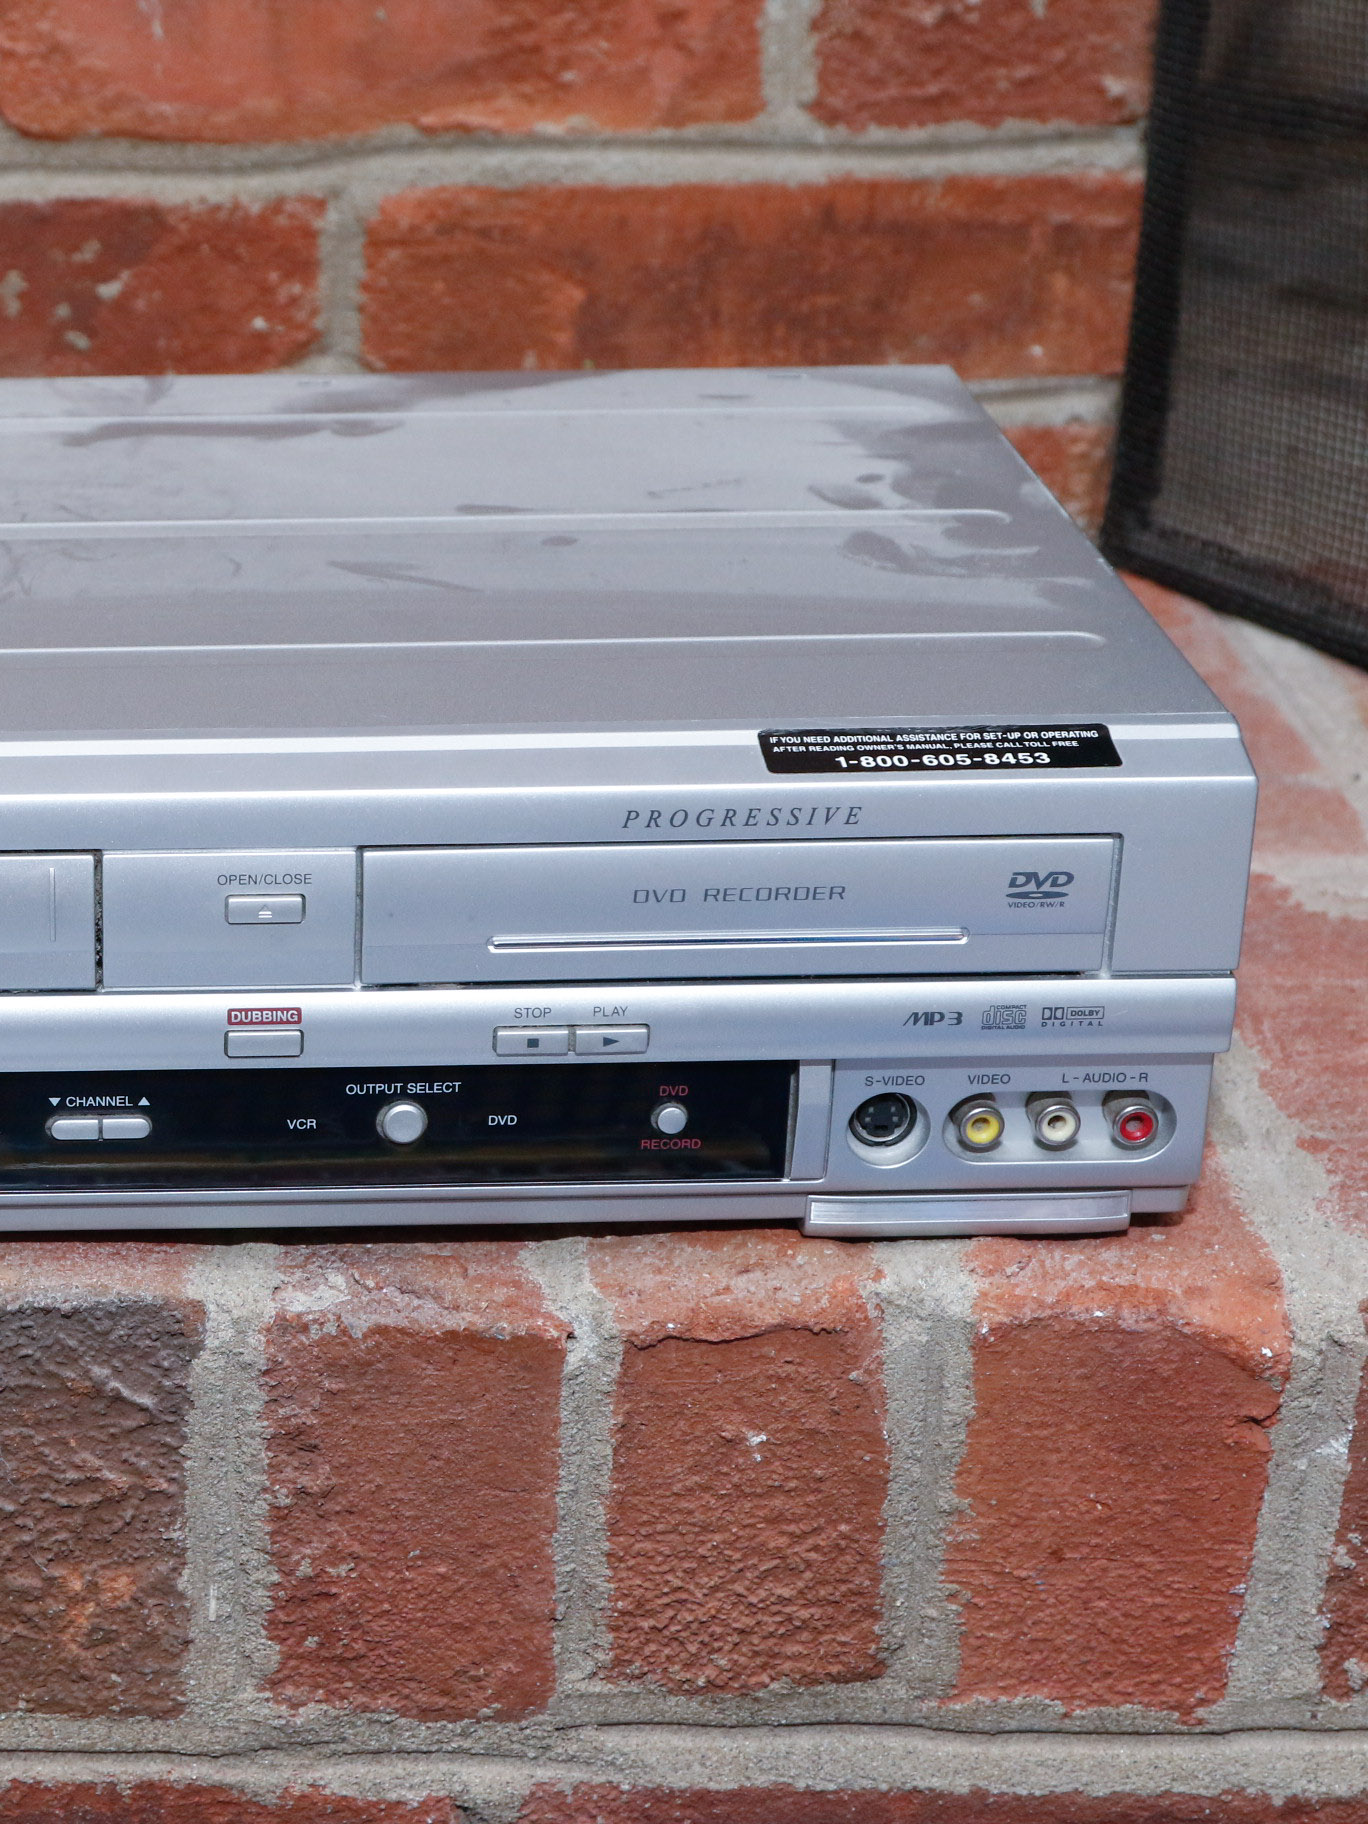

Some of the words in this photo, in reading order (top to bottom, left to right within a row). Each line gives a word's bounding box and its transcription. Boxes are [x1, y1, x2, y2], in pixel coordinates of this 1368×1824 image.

[769, 736, 779, 744] IF
[780, 736, 801, 744] YOU
[803, 736, 831, 744] NEED
[833, 734, 894, 743] ADDITIONAL
[896, 733, 958, 742] ASSISTANCE
[960, 732, 981, 741] FOR
[983, 731, 1021, 740] SET-UP
[1023, 731, 1040, 739] OR
[1040, 730, 1099, 739] OPERATING
[835, 752, 1051, 768] 1-800-605-8453
[622, 806, 863, 829] PROGRESSIVE
[217, 872, 313, 886] OPEN/CLOSE
[1008, 871, 1075, 890] DVD
[633, 888, 687, 904] DVD
[703, 885, 846, 903] RECORDER
[1007, 901, 1065, 909] VIDEO/RW/R
[230, 1009, 299, 1023] DUBBING
[513, 1007, 552, 1019] STOP
[592, 1006, 628, 1017] PLAY
[1070, 1009, 1101, 1017] DOLBY
[903, 1011, 963, 1027] MP3
[865, 1075, 926, 1087] S-VIDEO
[967, 1073, 1011, 1086] VIDEO
[345, 1082, 403, 1096] OUTPUT
[406, 1081, 462, 1094] SELECT
[659, 1085, 689, 1097] DVD
[65, 1096, 133, 1108] CHANNEL
[286, 1119, 317, 1130] VCR
[488, 1115, 518, 1126] DVD
[640, 1138, 702, 1150] RECORD
